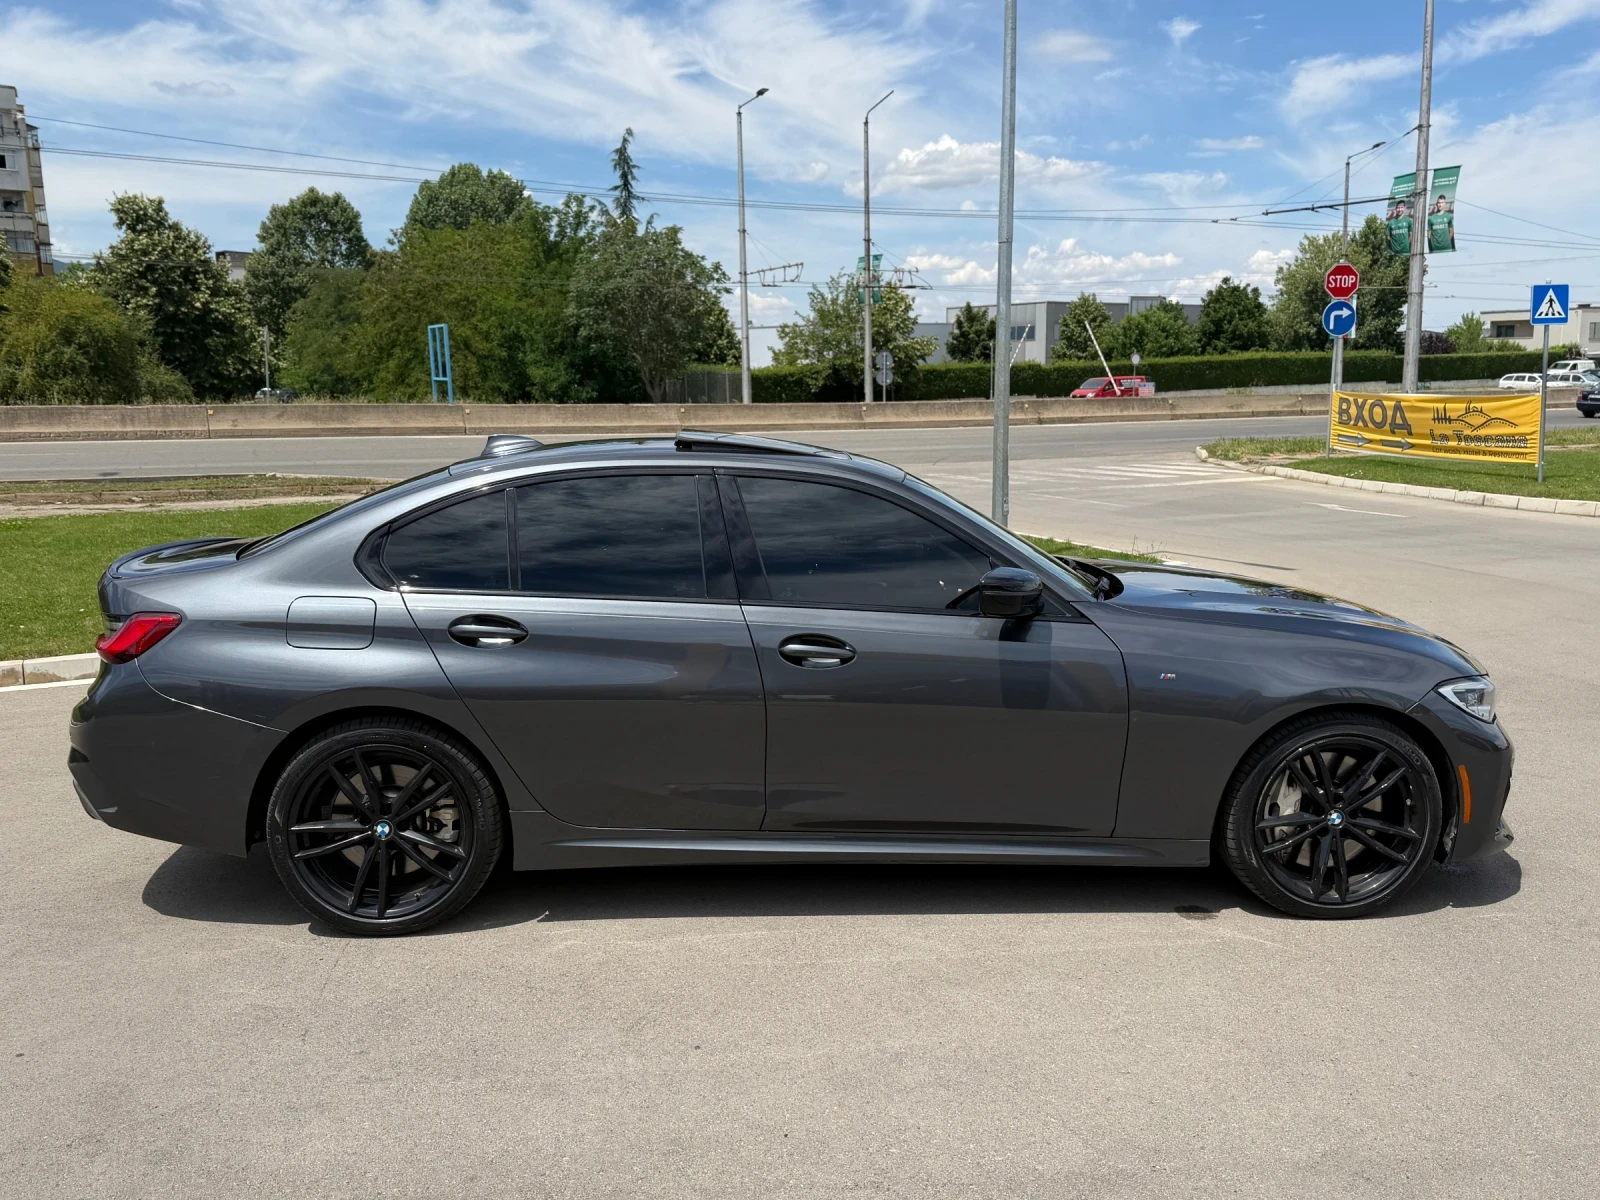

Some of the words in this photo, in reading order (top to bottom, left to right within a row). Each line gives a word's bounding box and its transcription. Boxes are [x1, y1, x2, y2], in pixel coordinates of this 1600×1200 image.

[1328, 275, 1356, 288] STOP
[1338, 397, 1413, 435] ВХОД
[1430, 429, 1450, 445] La
[1452, 430, 1528, 448] Toscana
[1487, 450, 1528, 459] Restaurant
